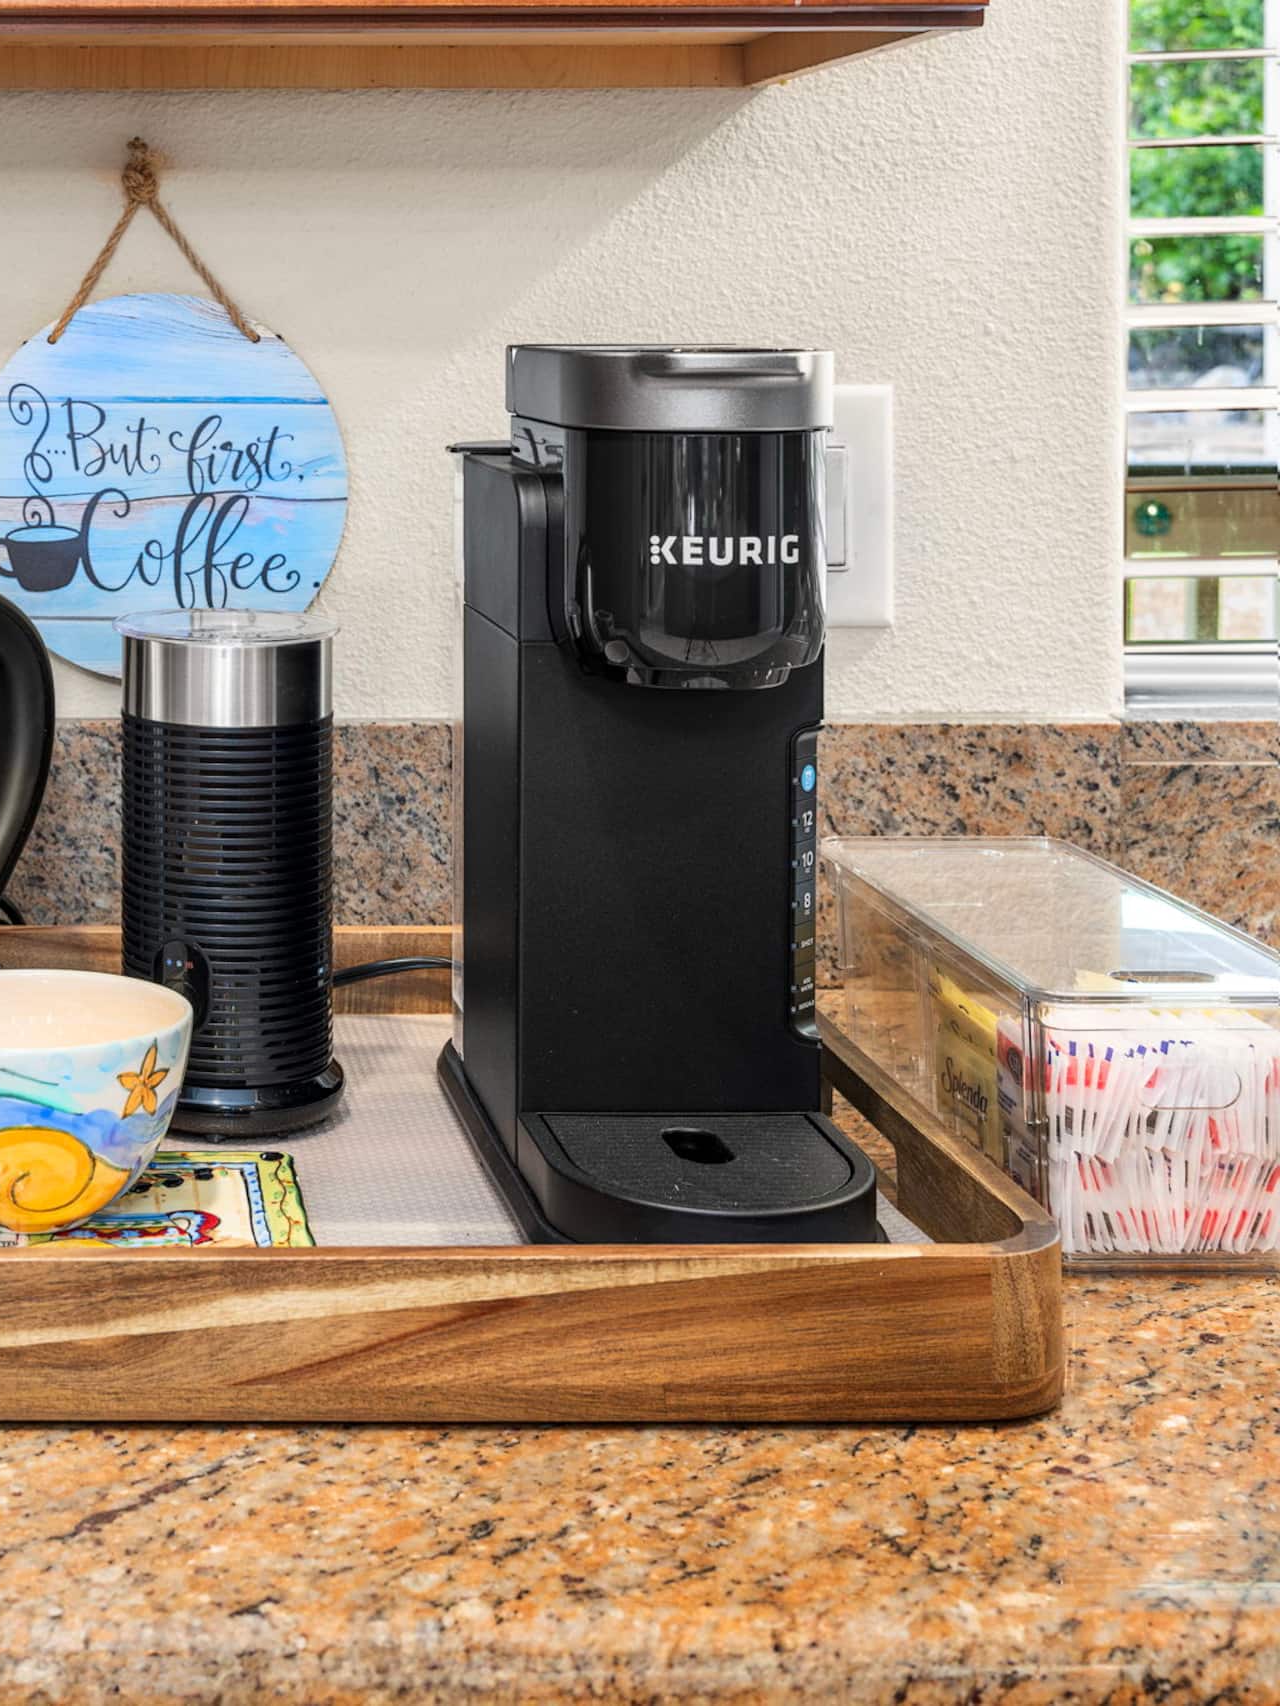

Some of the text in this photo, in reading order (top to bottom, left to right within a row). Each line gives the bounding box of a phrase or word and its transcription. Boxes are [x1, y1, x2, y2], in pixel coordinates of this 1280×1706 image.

[81, 488, 321, 609] Coffee.
[649, 534, 800, 566] KEURIG
[802, 810, 814, 827] 12
[802, 850, 814, 868] 10
[803, 892, 812, 908] 8
[940, 1056, 989, 1114] Splenda
